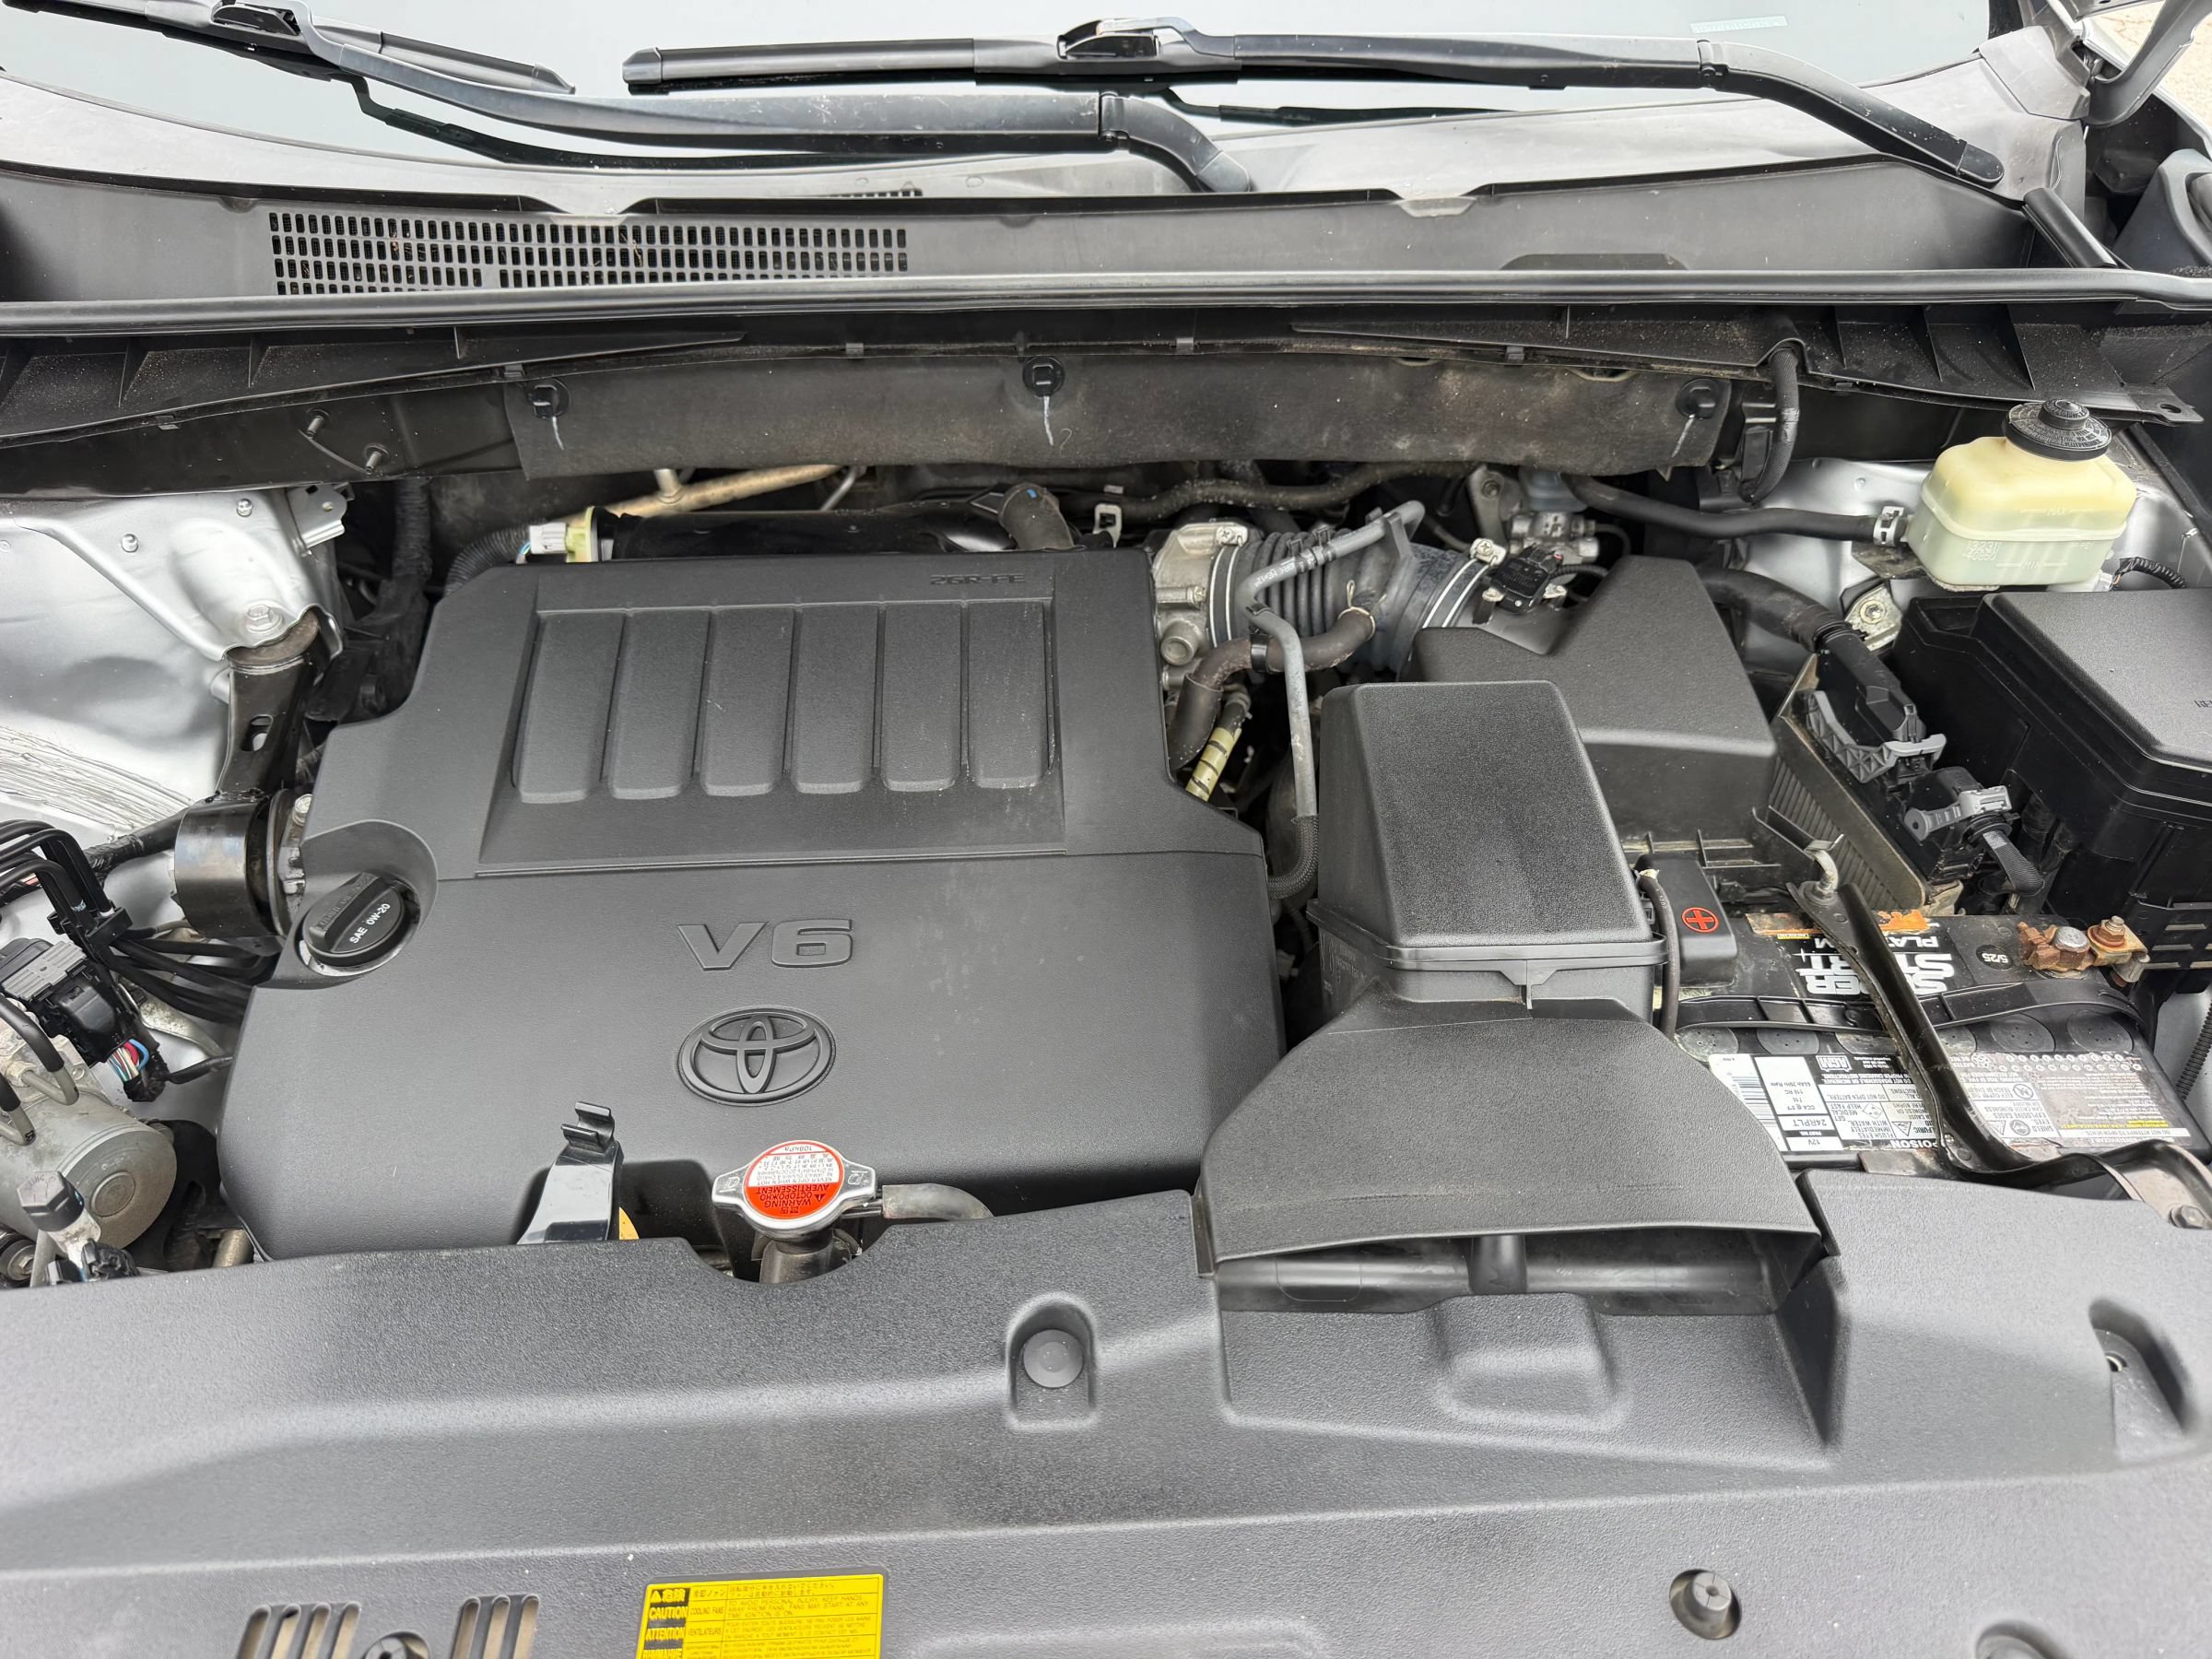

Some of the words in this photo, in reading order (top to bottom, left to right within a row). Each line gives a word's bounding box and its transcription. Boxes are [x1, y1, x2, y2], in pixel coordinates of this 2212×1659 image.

[930, 572, 1026, 585] 2GR-FE
[349, 926, 368, 944] SAE
[366, 903, 391, 925] 0W-20
[677, 918, 853, 971] V6
[1983, 953, 2008, 963] 5/25
[756, 1183, 830, 1194] AVERTISSEMENT
[759, 1191, 813, 1202] ОСТОРОЖНО
[765, 1198, 811, 1208] WARNING
[649, 1606, 688, 1619] CAUTION
[645, 1628, 686, 1640] ATTENTION
